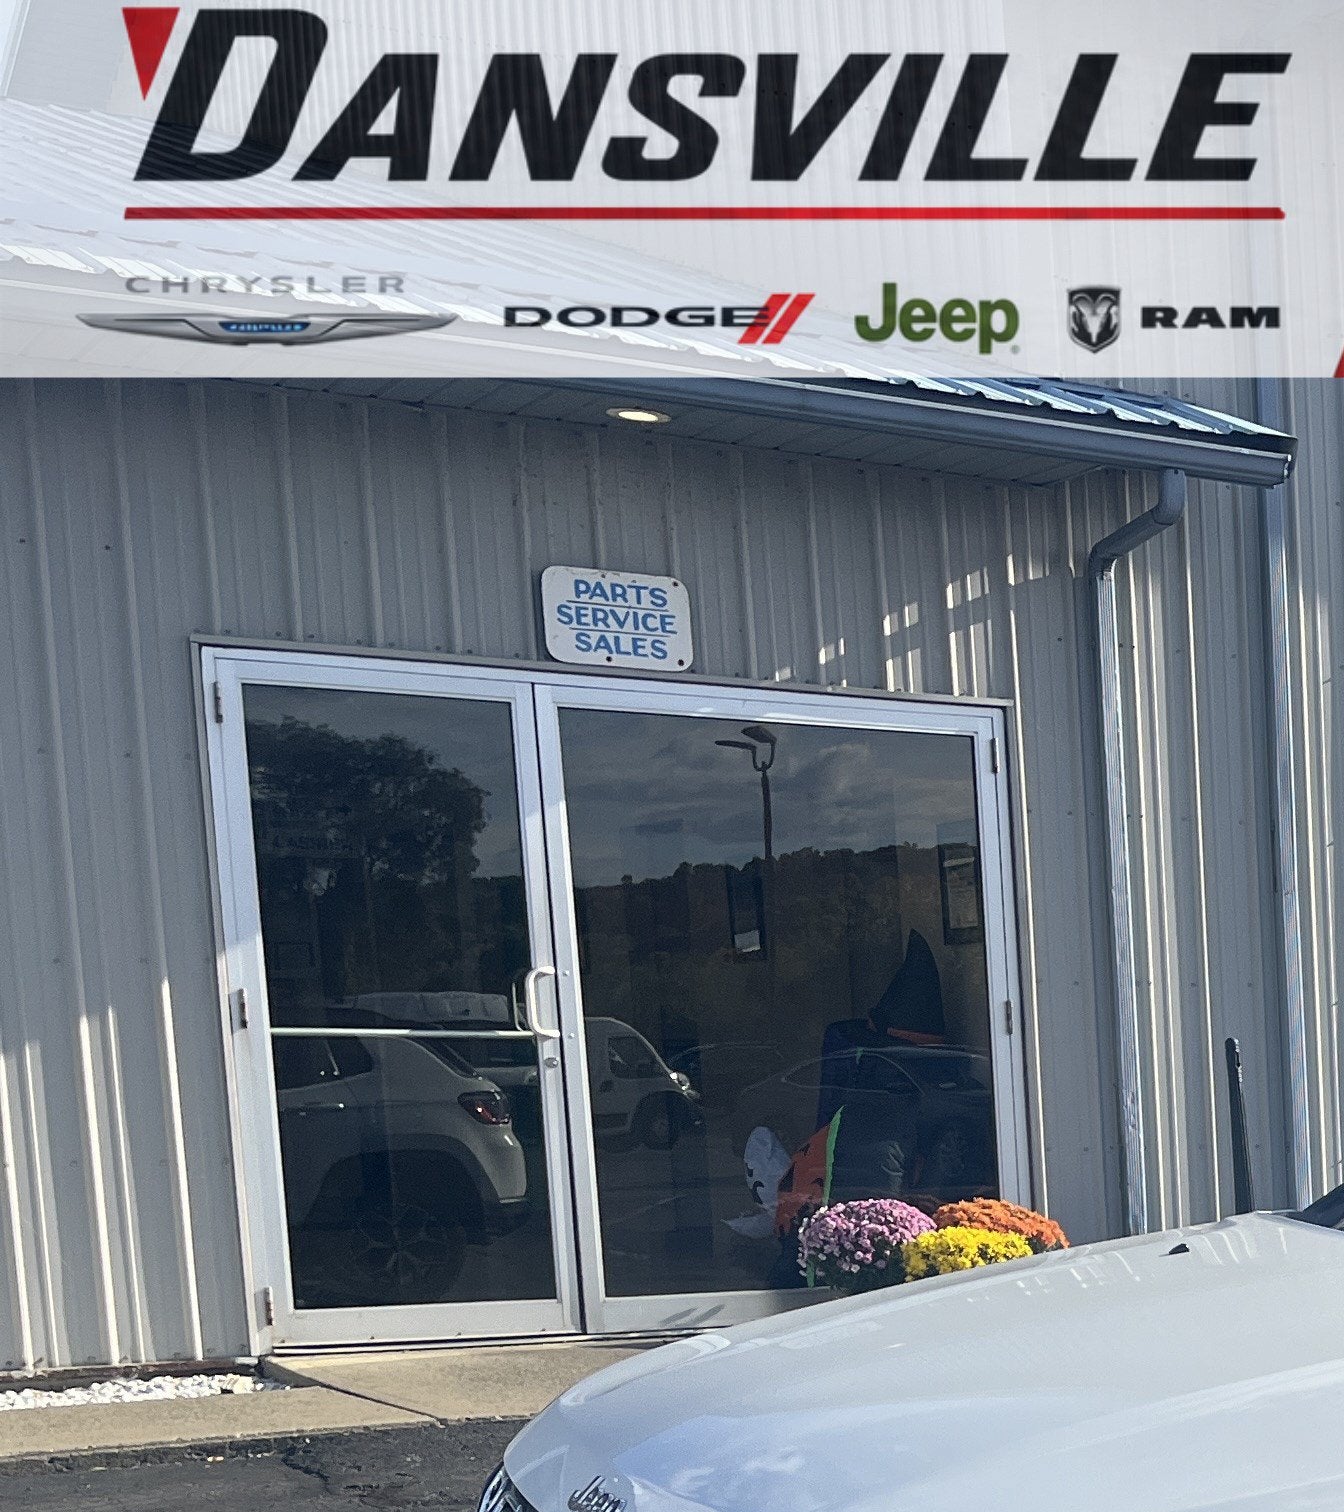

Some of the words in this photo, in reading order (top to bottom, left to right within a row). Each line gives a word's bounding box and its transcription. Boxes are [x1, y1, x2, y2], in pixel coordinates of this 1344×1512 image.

[573, 578, 668, 608] PARTS
[556, 603, 677, 635] SERVICE
[575, 631, 668, 660] SALES
